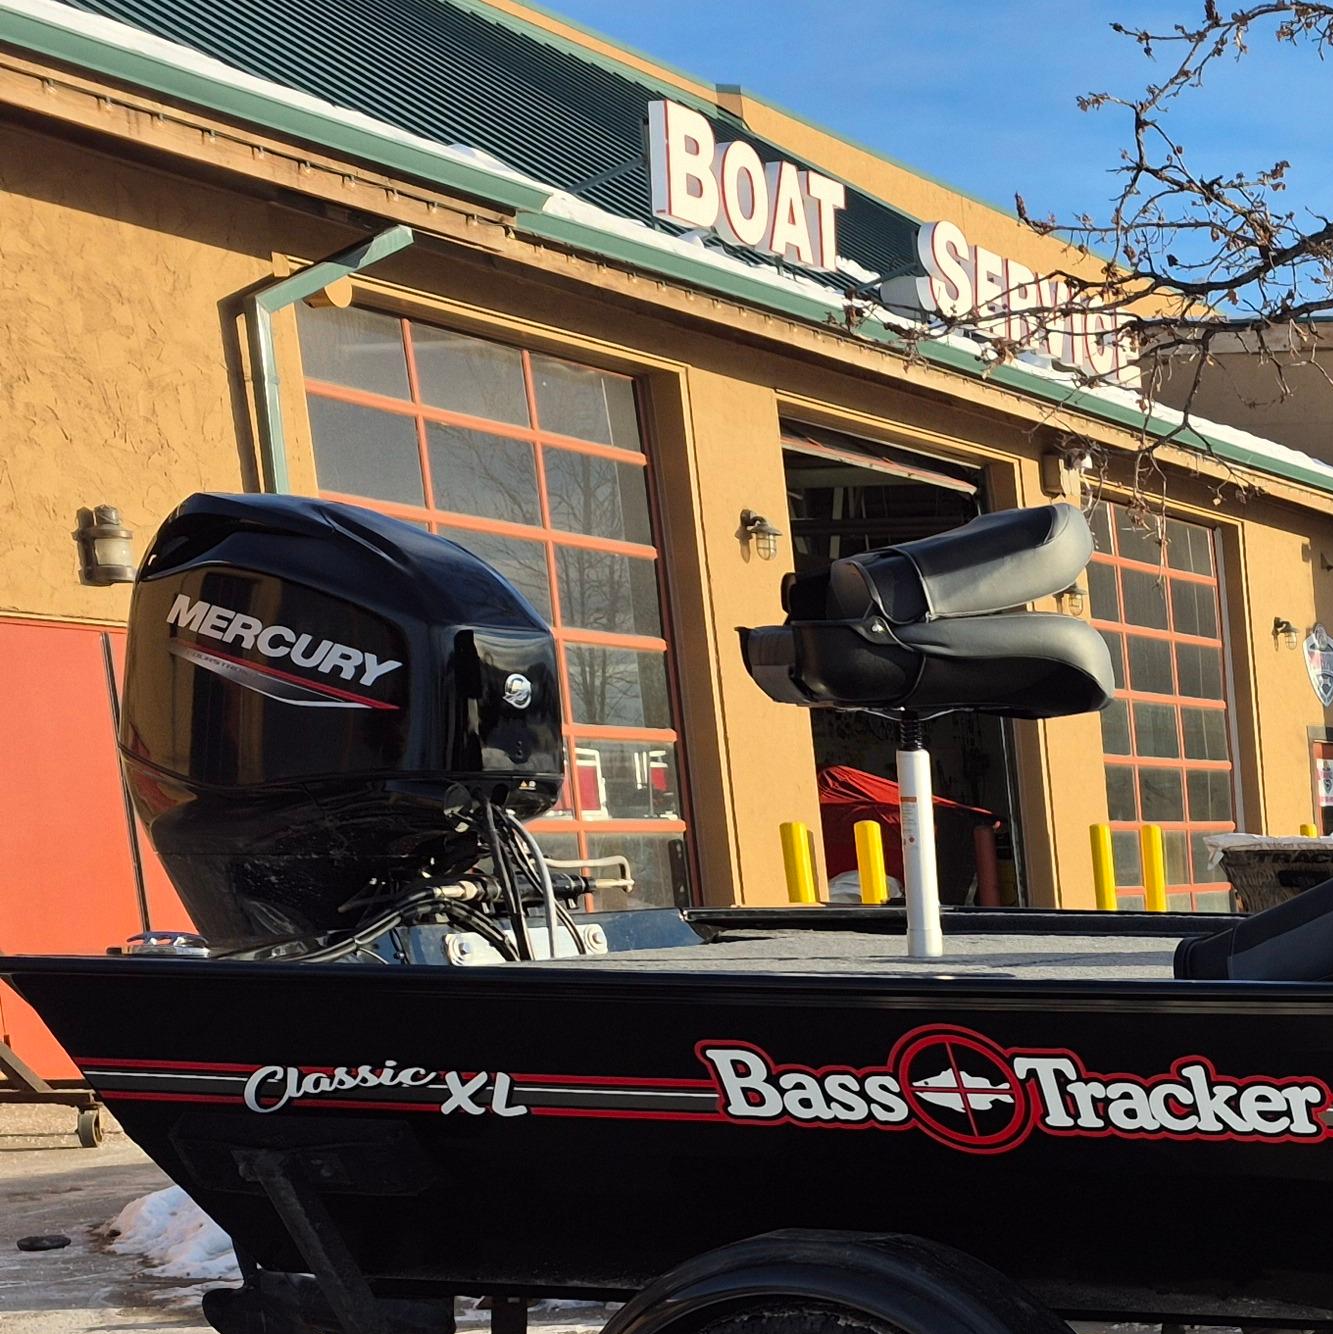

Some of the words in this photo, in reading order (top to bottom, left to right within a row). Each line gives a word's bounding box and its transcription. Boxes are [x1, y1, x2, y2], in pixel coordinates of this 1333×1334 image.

[652, 100, 845, 272] BOAT
[166, 593, 402, 686] MERCURY
[244, 1060, 437, 1113] Classic
[441, 1071, 528, 1117] XL
[706, 1049, 908, 1121] Bass
[1013, 1056, 1321, 1133] Tracker
